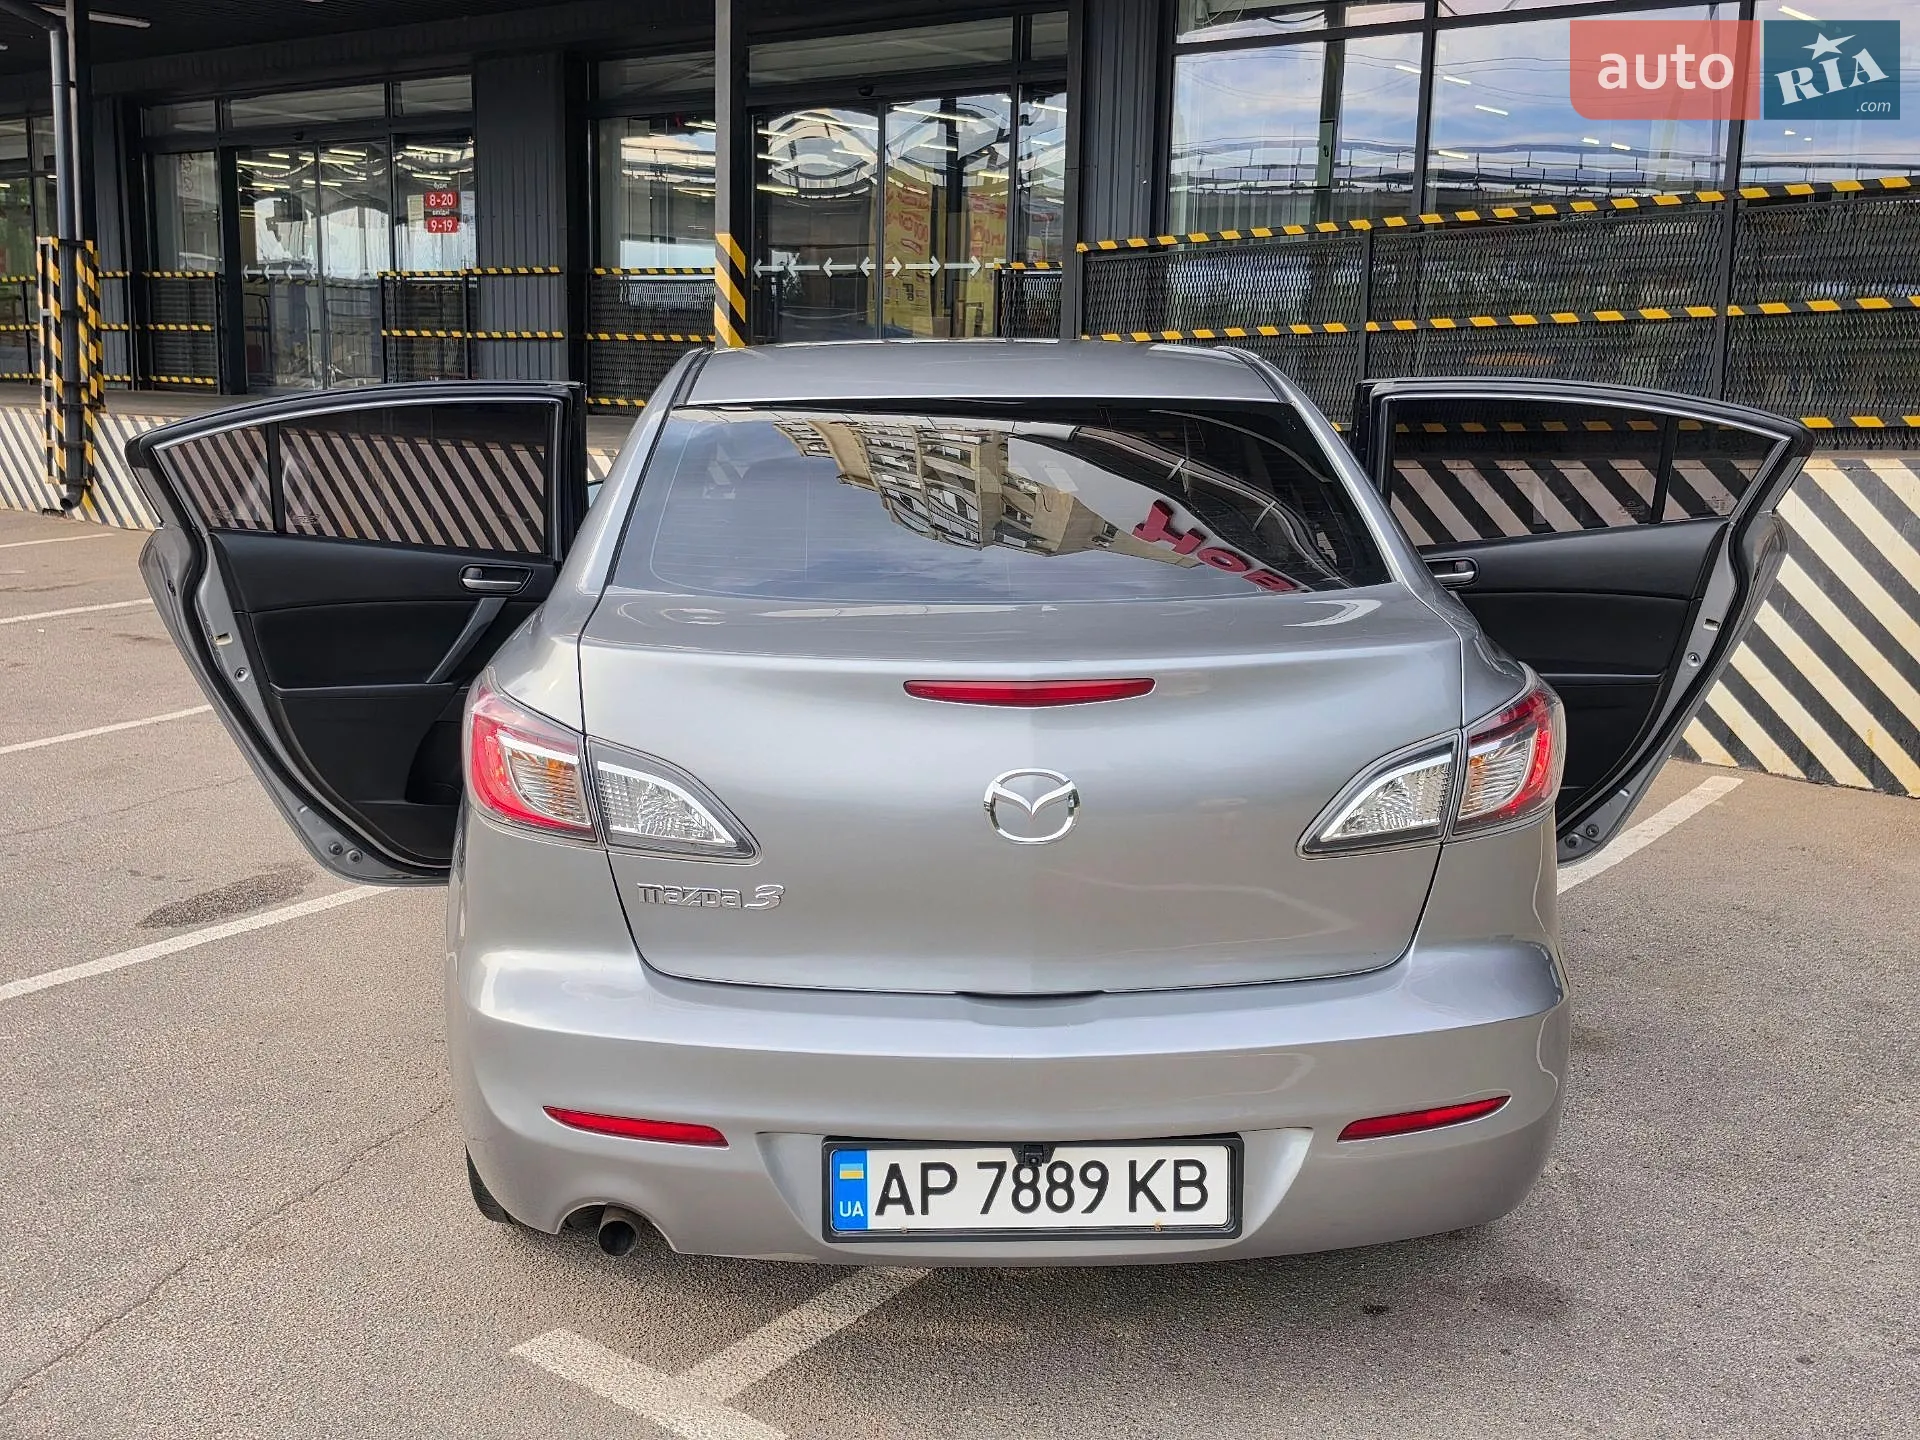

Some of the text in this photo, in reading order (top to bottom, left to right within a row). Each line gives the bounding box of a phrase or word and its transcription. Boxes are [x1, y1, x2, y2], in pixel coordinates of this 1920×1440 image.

[429, 193, 453, 206] 8-20
[431, 219, 453, 232] 9-19
[744, 884, 785, 910] 3
[874, 1158, 1210, 1216] AP 7889 KB
[839, 1202, 864, 1216] UA
